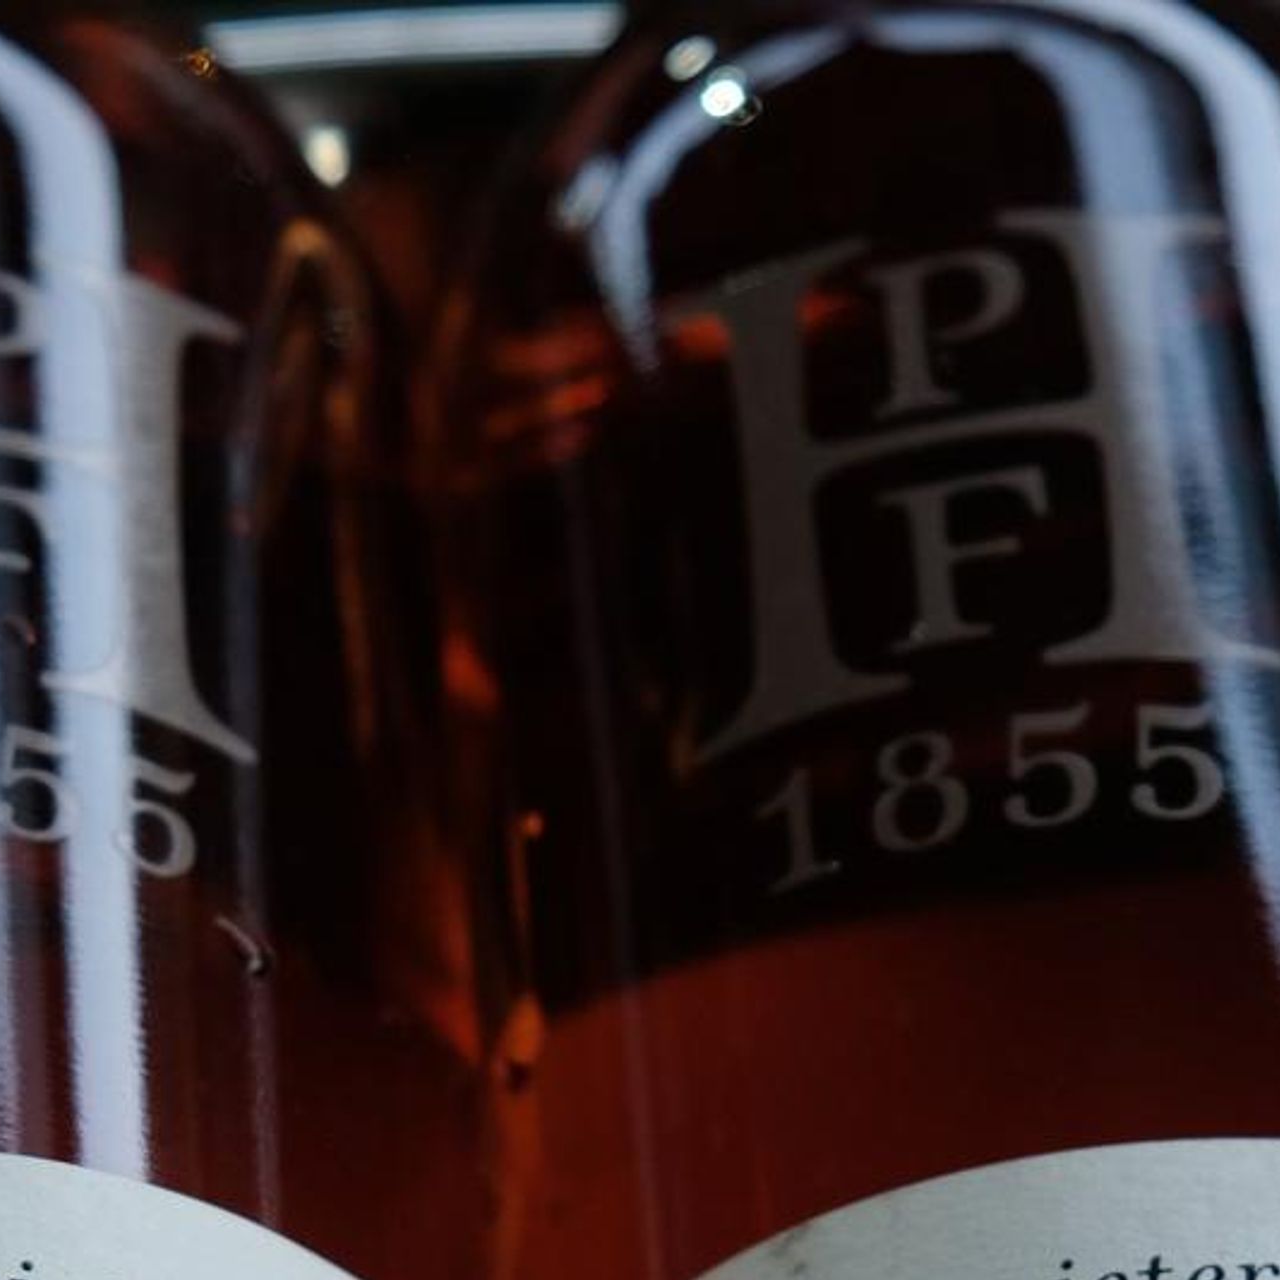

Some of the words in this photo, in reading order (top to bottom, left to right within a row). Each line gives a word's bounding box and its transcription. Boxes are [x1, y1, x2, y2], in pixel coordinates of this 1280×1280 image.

[865, 249, 1025, 420] P
[875, 465, 1050, 653] F
[756, 700, 1226, 893] 1855
